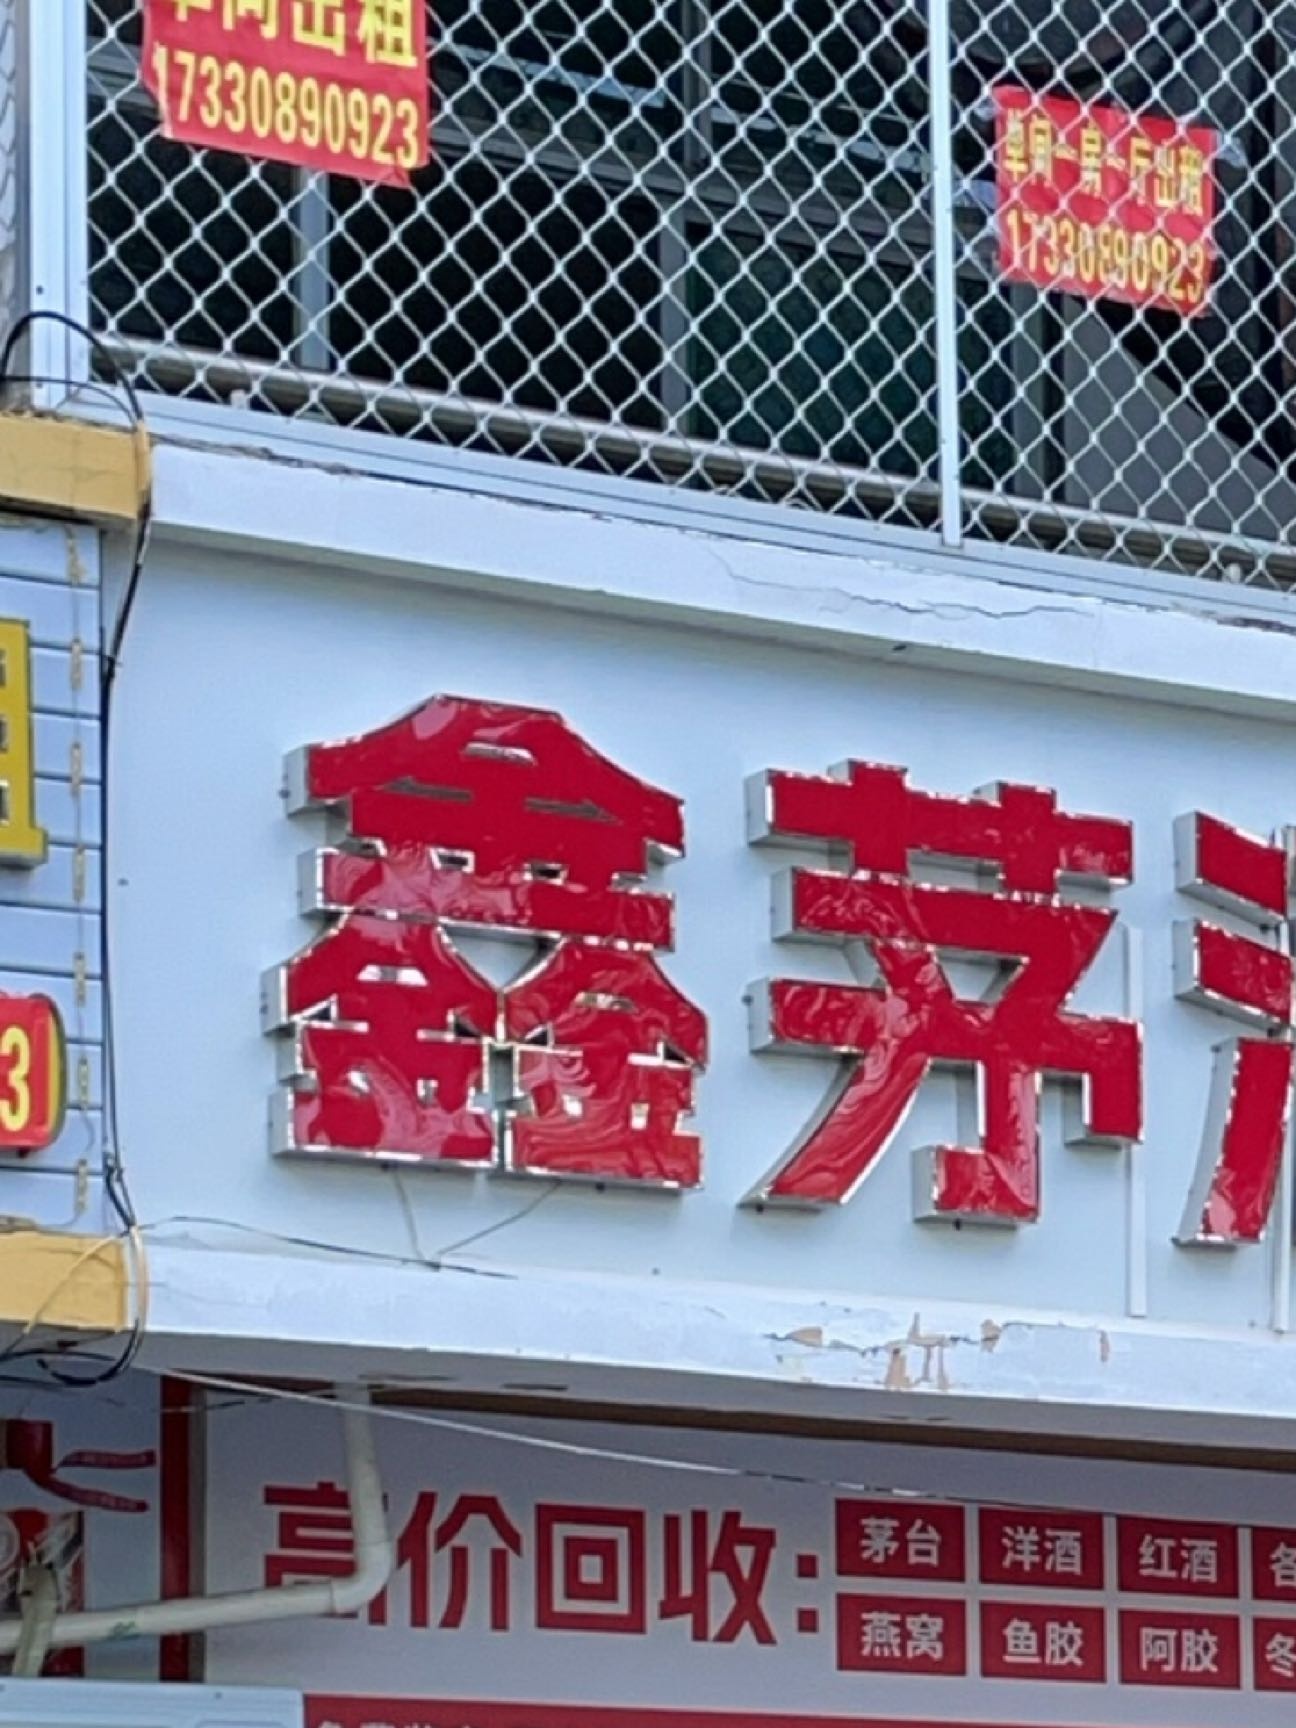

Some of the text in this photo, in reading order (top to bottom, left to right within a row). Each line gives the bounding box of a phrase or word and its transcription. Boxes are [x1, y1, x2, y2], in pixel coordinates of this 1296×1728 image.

[172, 0, 417, 67] 出租
[154, 43, 418, 168] 17330890923
[860, 1517, 942, 1568] 茅台
[1001, 1525, 1083, 1575] 洋酒
[1138, 1534, 1219, 1584] 红酒
[861, 1611, 944, 1660] 燕窝
[1002, 1618, 1084, 1667] 鱼胶
[1141, 1627, 1220, 1673] 阿胶
